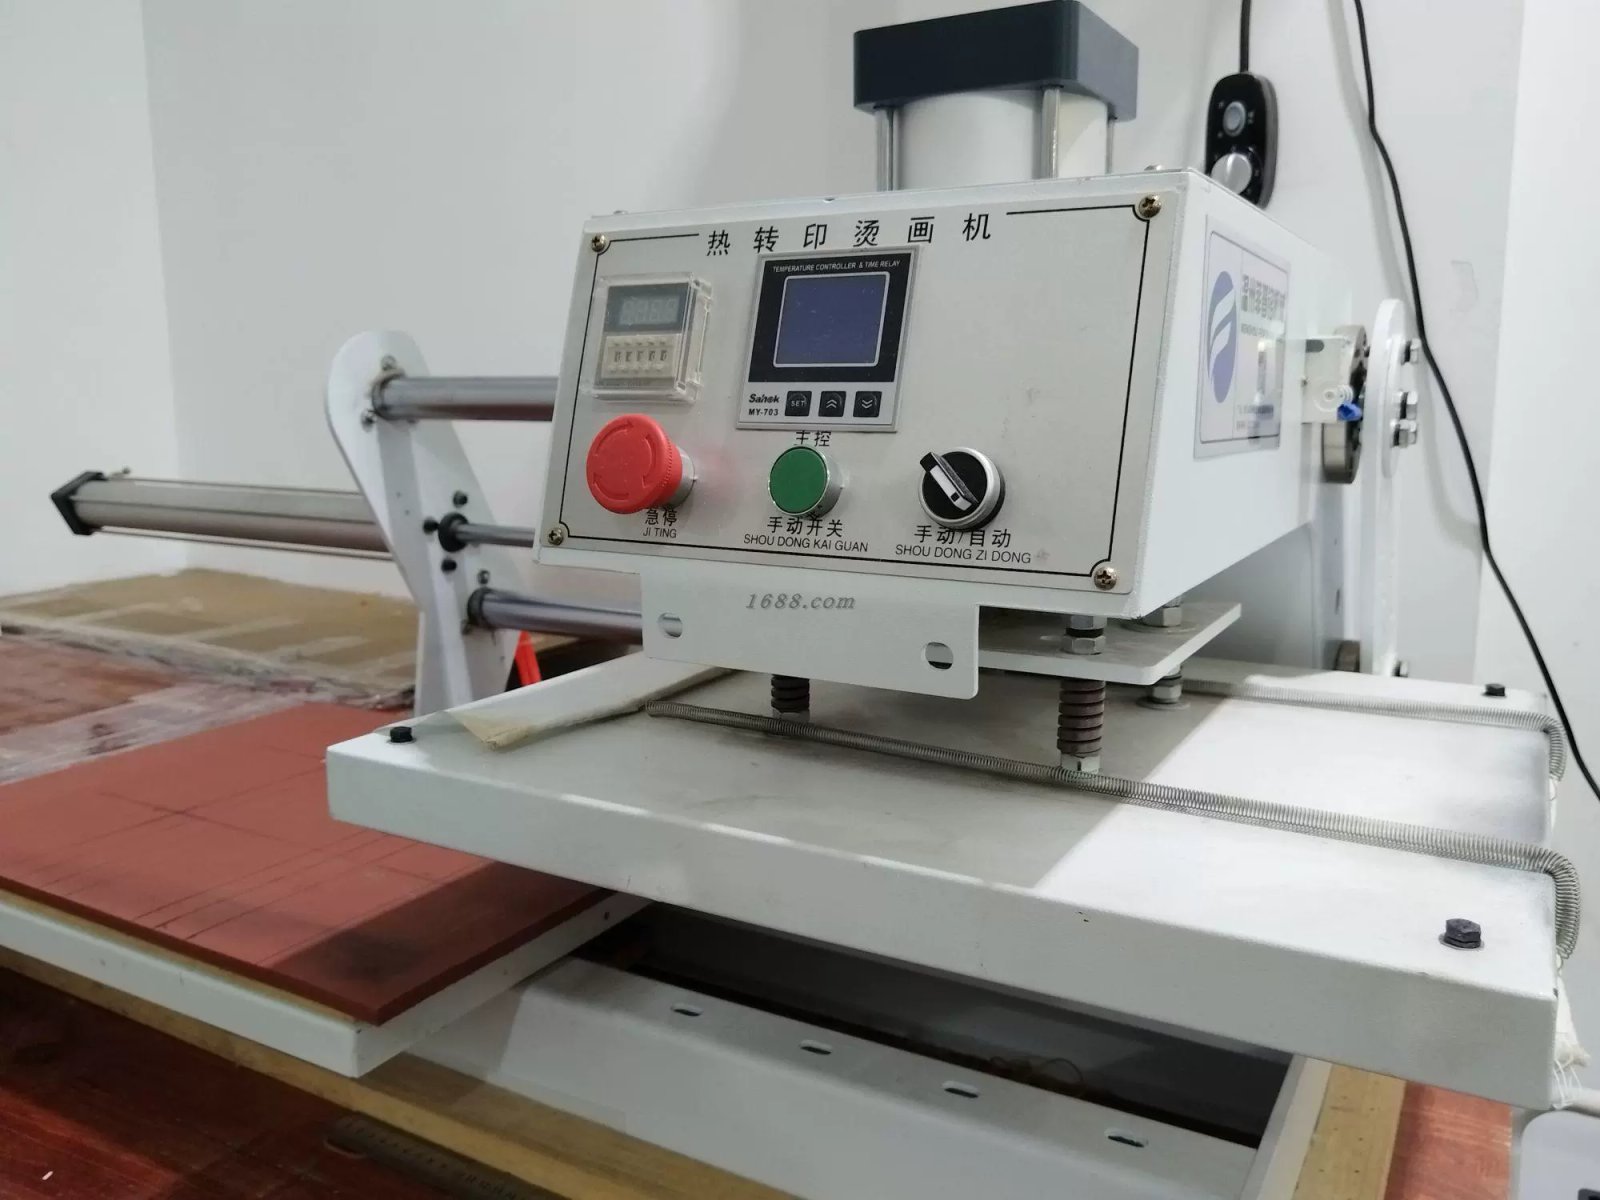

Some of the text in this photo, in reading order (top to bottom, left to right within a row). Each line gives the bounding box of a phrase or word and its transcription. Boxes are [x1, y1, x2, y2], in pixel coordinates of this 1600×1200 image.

[706, 212, 991, 257] 热转印烫画机
[772, 263, 815, 273] TEMPERATURE
[815, 262, 856, 271] CONTROLLER
[858, 261, 864, 269] &
[880, 259, 901, 268] RELAY
[748, 408, 779, 416] MY-703
[645, 508, 677, 527] 急停
[767, 516, 843, 537] 手动开关
[643, 527, 677, 539] JI TING
[914, 525, 1012, 549] 手动/自动
[743, 534, 869, 553] SHOU DONG KAI GUAN
[895, 544, 1032, 564] SHOU DONG ZI DONG
